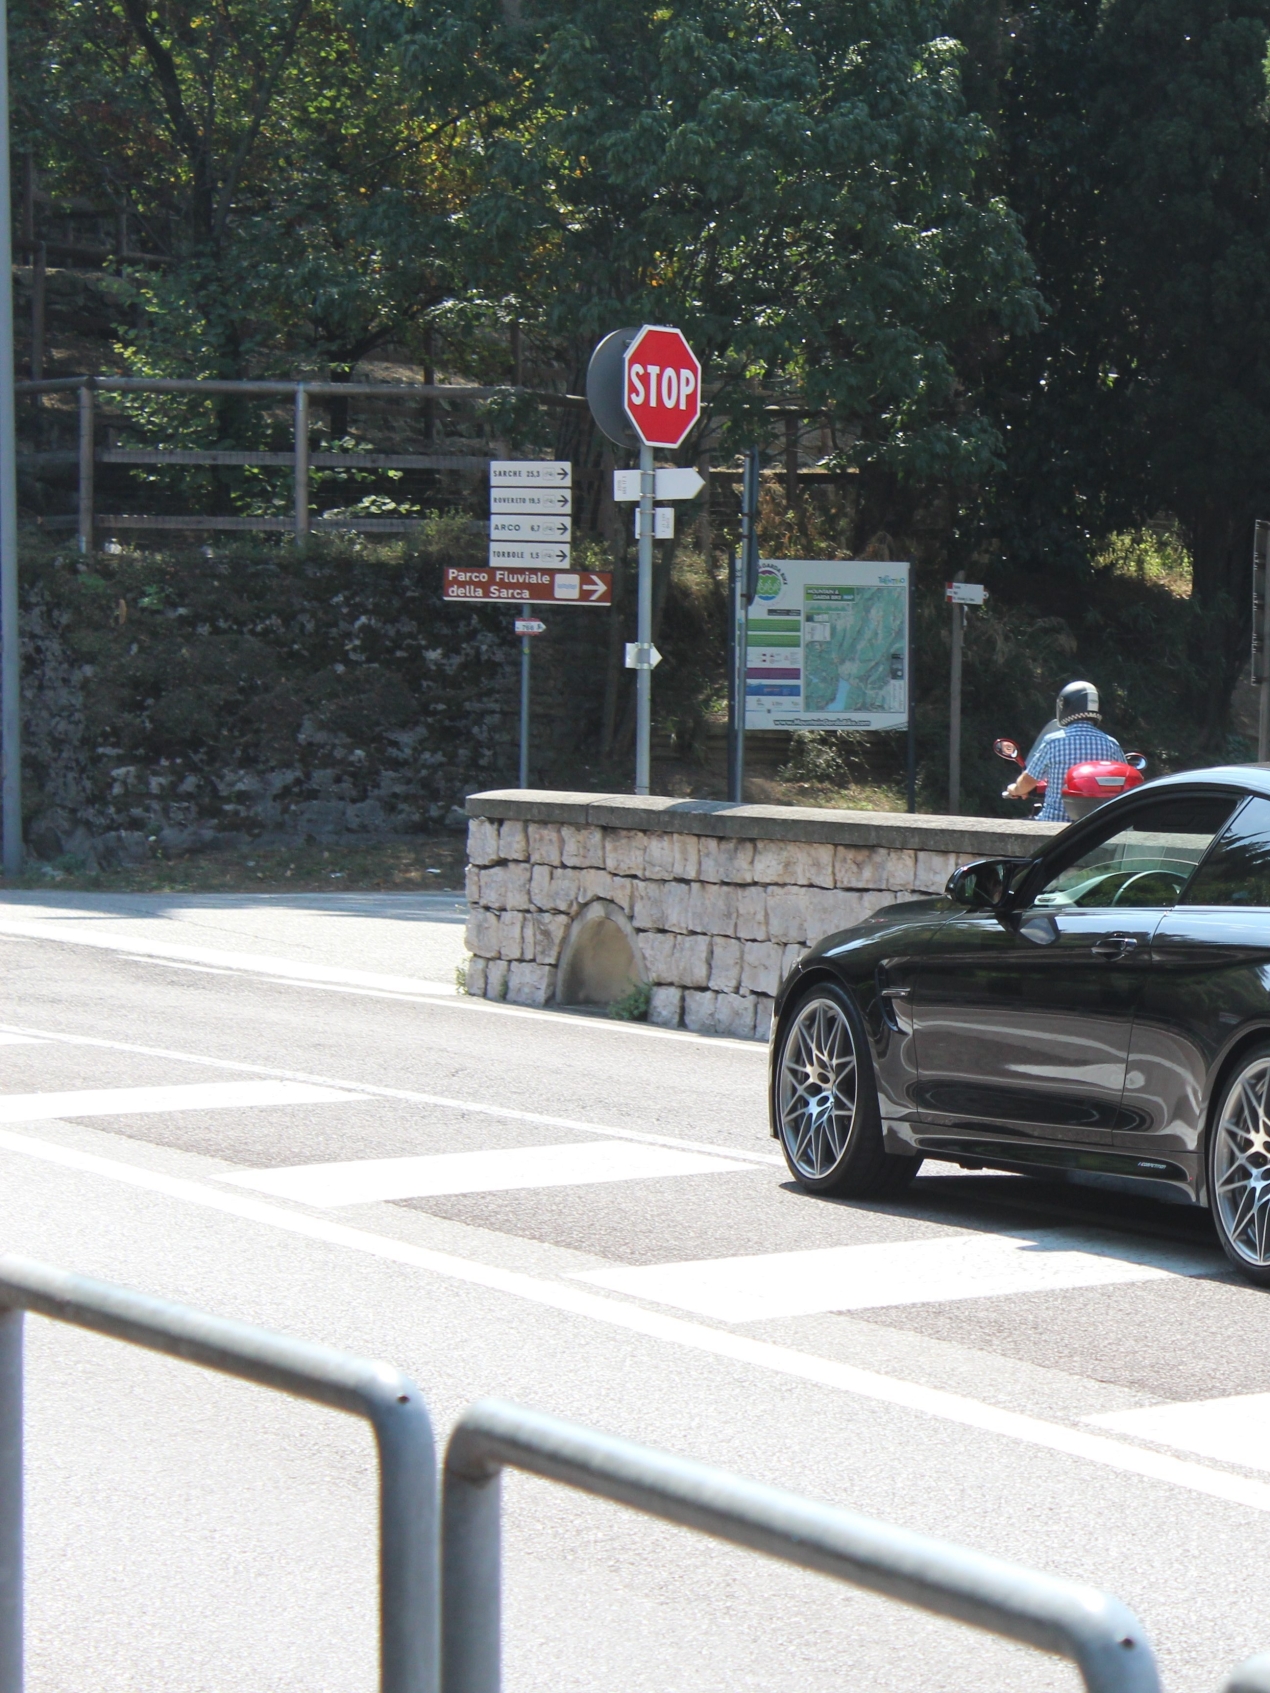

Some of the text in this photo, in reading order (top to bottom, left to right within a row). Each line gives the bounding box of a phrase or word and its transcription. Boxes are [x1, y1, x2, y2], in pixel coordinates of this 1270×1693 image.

[630, 363, 696, 411] STOP
[493, 470, 522, 478] SARCHE
[493, 523, 521, 532] ARCO
[492, 550, 525, 559] TORBOLE
[448, 569, 550, 584] Parco Fluviale
[448, 585, 530, 598] della Sarca
